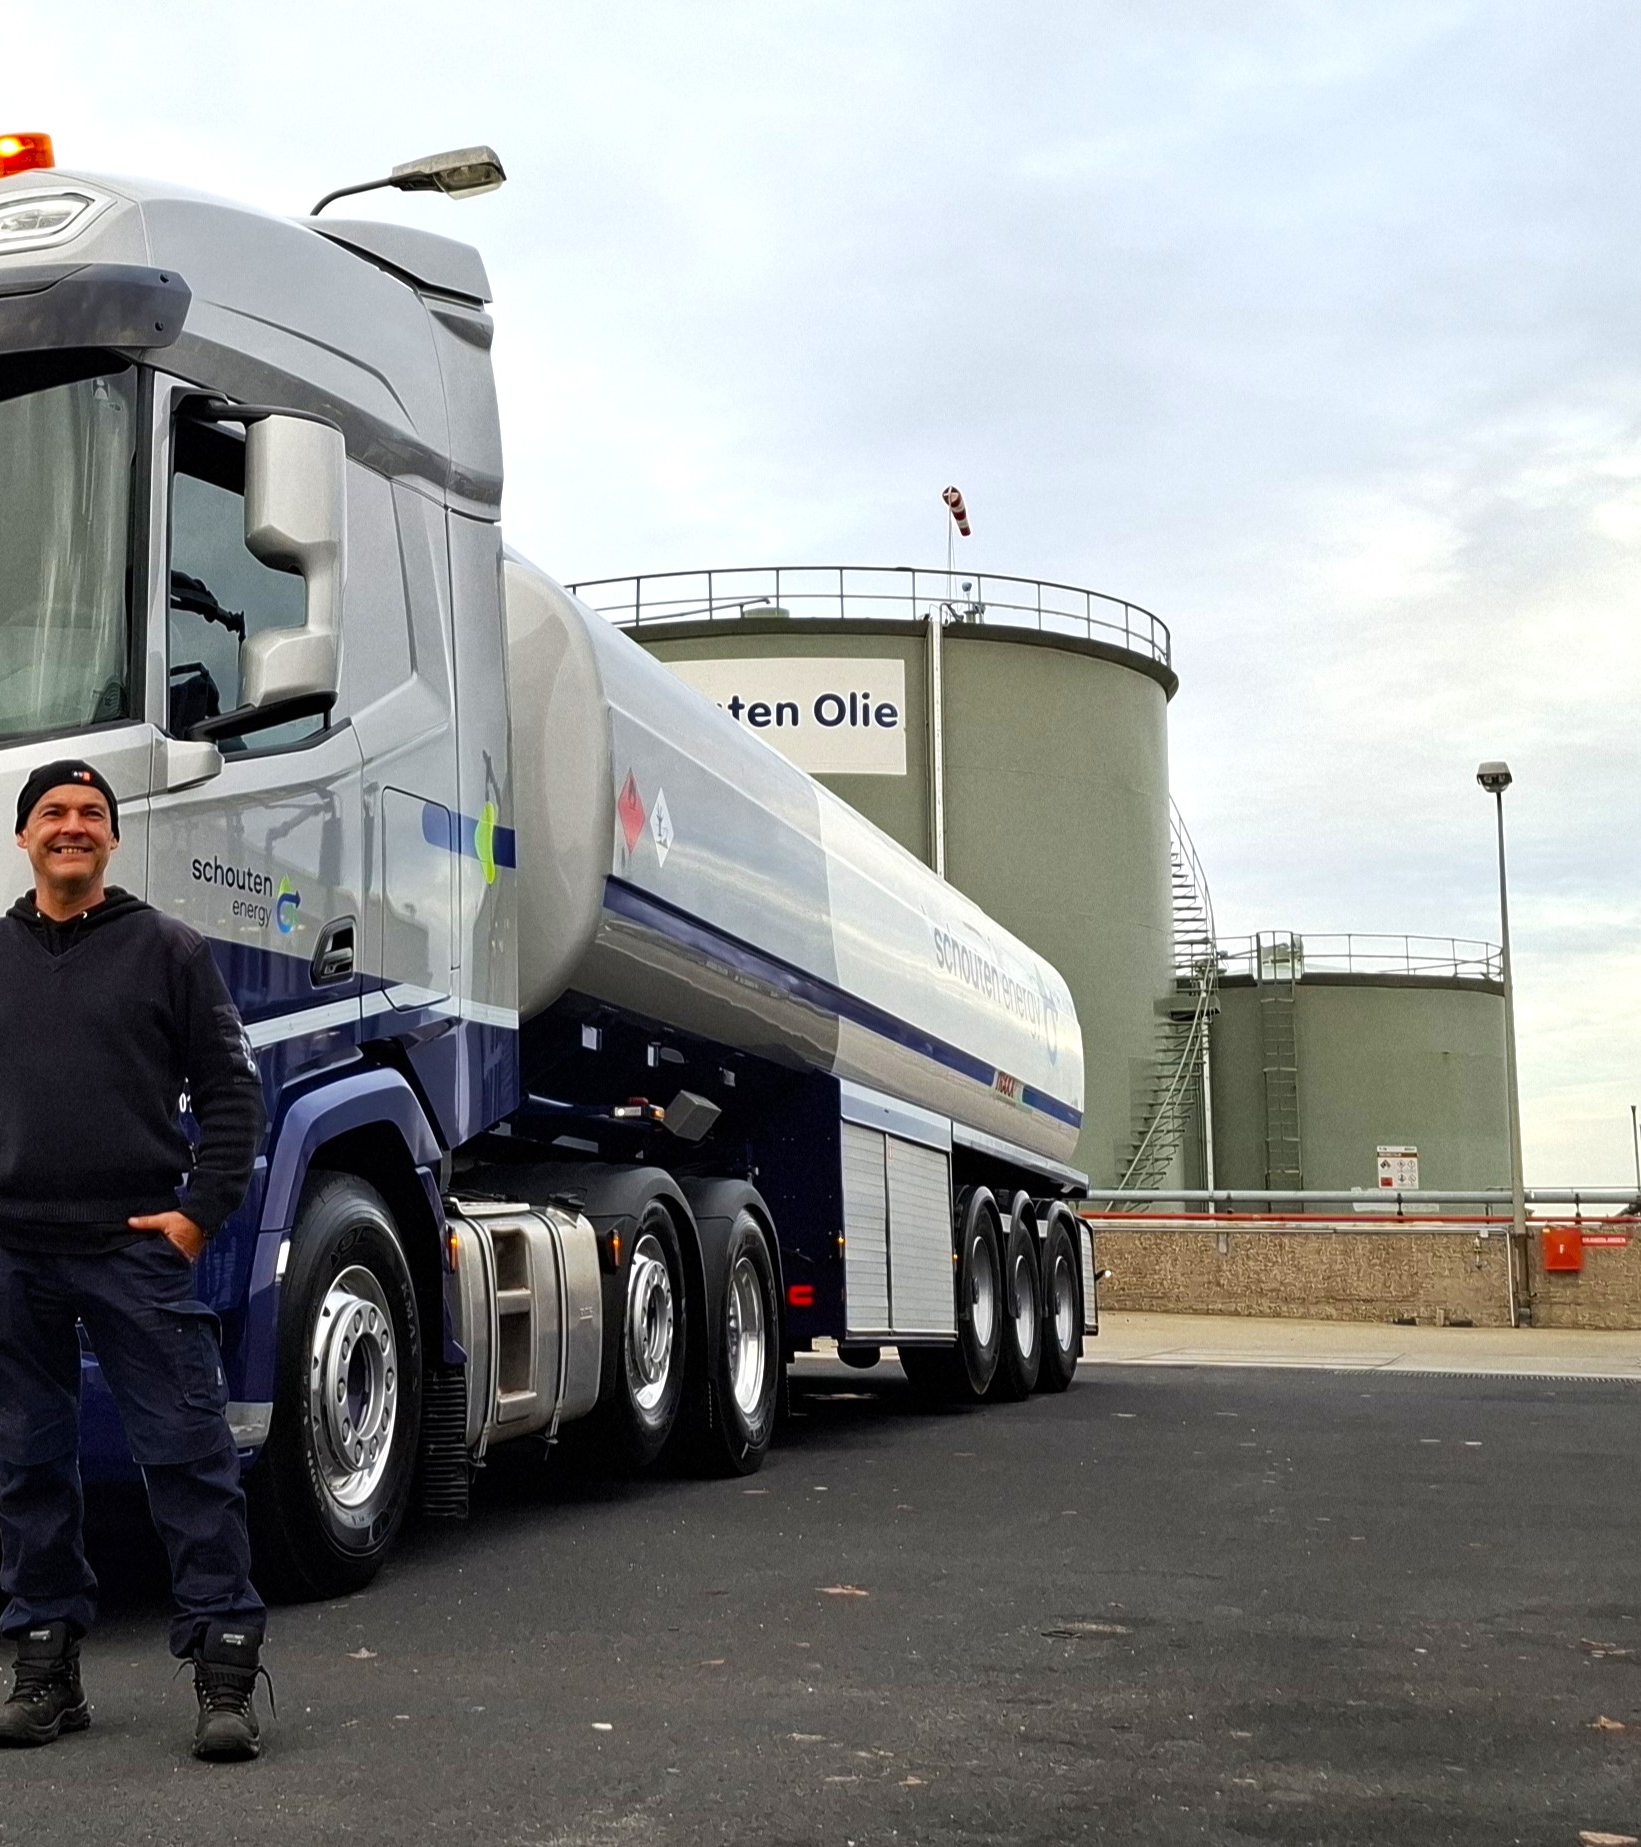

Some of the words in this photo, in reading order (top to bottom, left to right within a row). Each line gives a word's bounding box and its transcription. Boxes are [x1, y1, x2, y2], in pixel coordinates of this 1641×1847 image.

[717, 694, 799, 728] ten
[813, 691, 899, 728] Olie
[191, 855, 273, 898] schouten
[232, 899, 273, 929] energy
[934, 924, 1001, 1004] schouten
[1001, 976, 1043, 1040] energy
